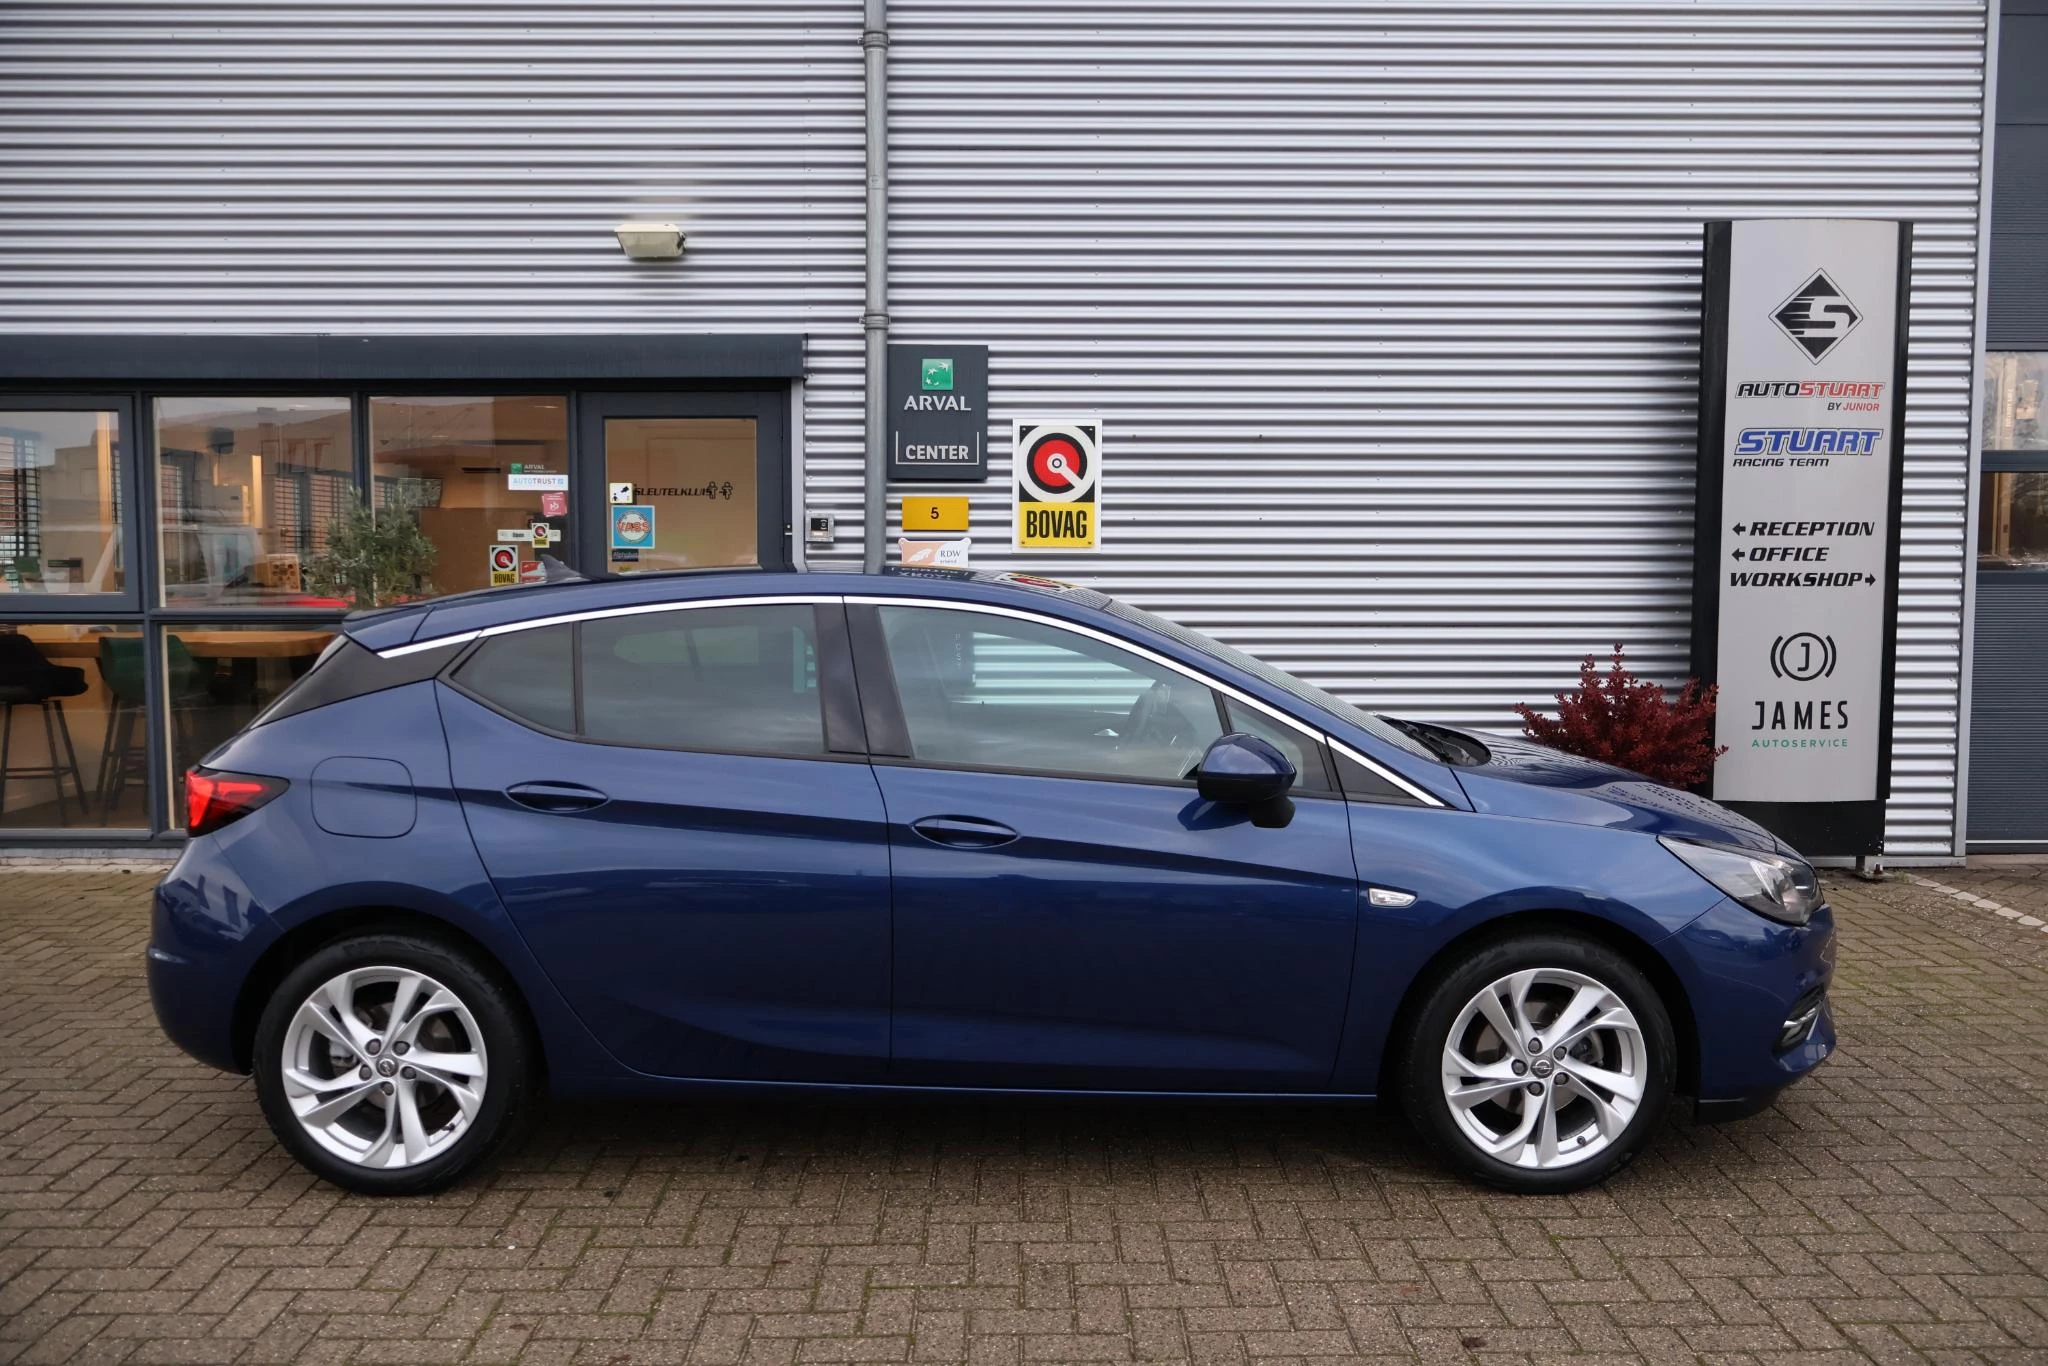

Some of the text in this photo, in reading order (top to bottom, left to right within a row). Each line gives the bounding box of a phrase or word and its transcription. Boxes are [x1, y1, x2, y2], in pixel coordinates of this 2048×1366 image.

[1736, 381, 1884, 399] AUTOSTUART
[903, 395, 972, 411] ARVAL
[1827, 402, 1880, 412] BY JUNIOR
[1735, 429, 1883, 455] STUART
[905, 444, 969, 460] CENTER
[1733, 458, 1830, 467] RACING TEAM
[512, 477, 557, 485] AUTOTRUST
[930, 506, 940, 520] 5
[1026, 510, 1088, 538] BOVAG
[1749, 521, 1875, 537] RECEPTION
[940, 550, 961, 558] RDW
[1749, 546, 1830, 562] OFFICE
[494, 573, 515, 584] BOVAG
[1730, 572, 1863, 587] WORKSHOP
[1752, 700, 1849, 730] JAMES
[1752, 738, 1848, 748] AUTOSERVICE
